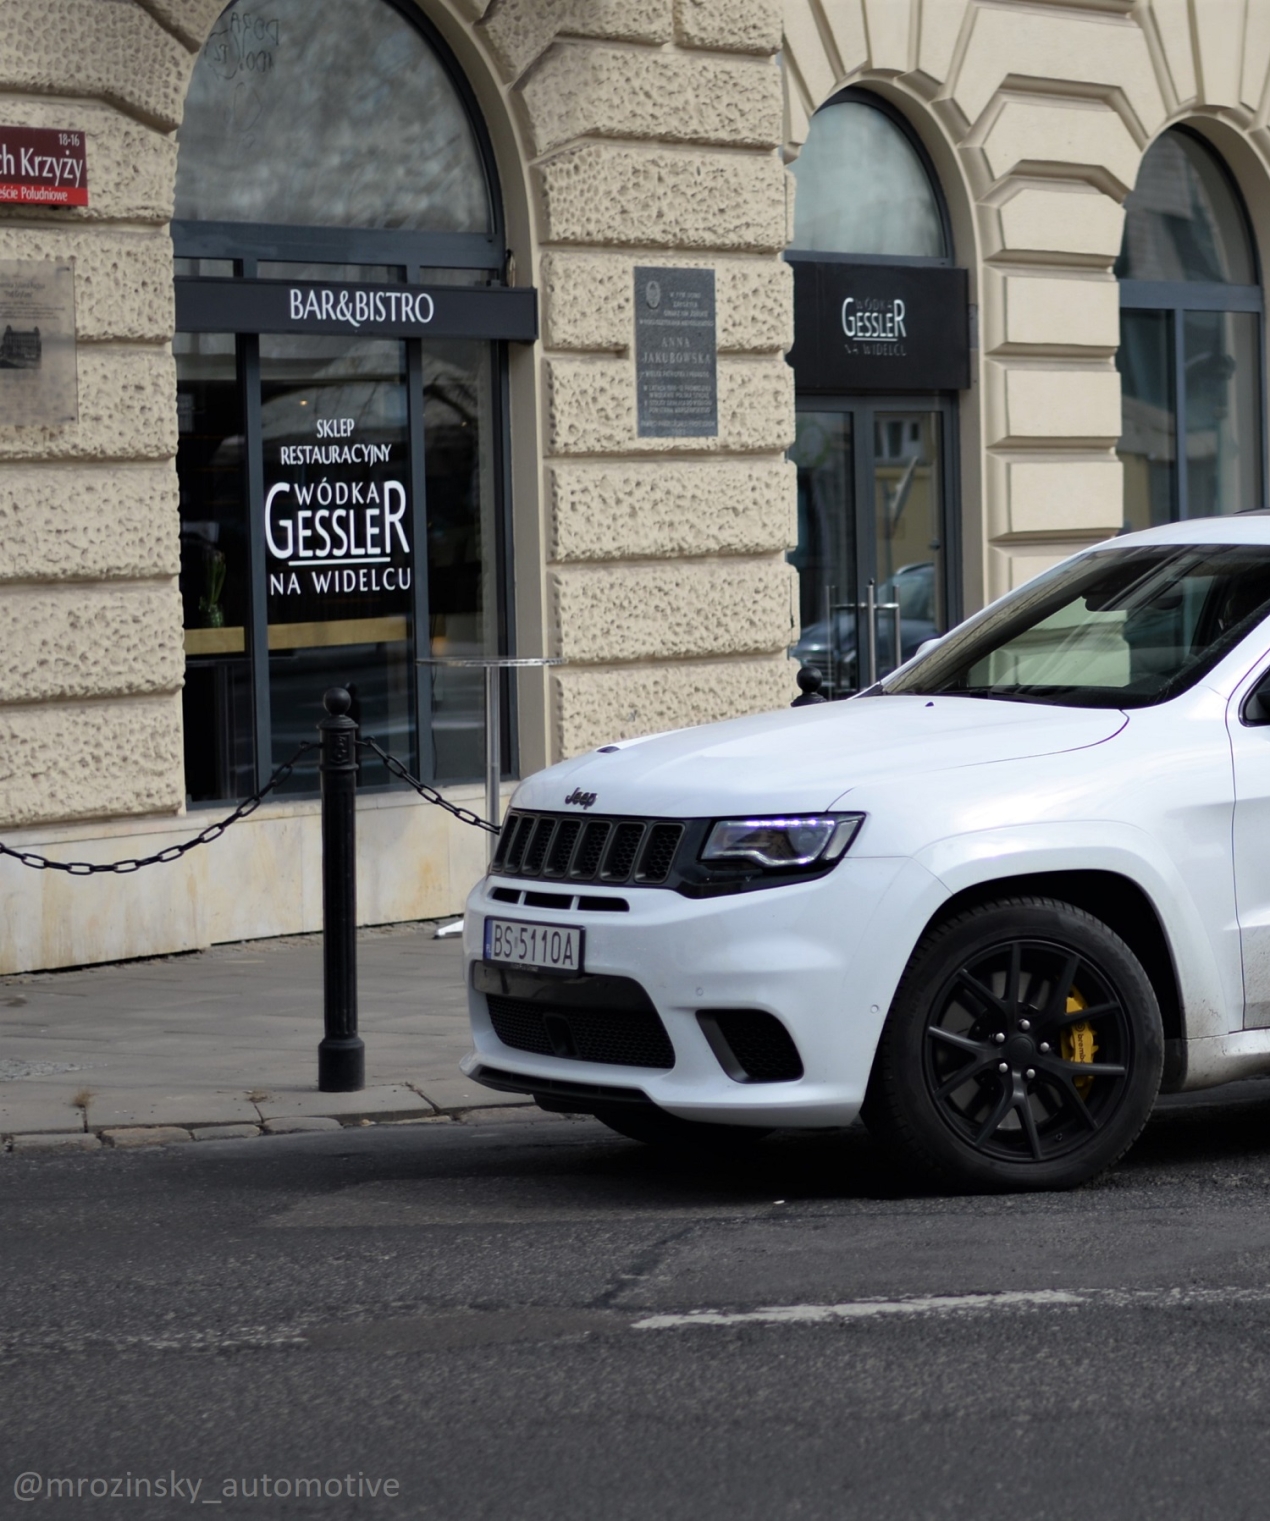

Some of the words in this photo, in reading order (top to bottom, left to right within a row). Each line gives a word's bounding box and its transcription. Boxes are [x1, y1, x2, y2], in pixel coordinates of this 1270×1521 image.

[58, 133, 80, 147] 18-16
[20, 147, 83, 188] Krzyży
[21, 186, 68, 201] Południowe
[290, 288, 435, 327] BAR&BISTRO
[841, 297, 907, 338] GESSLER
[661, 337, 690, 348] ANNA
[316, 418, 355, 438] SKLEP
[280, 444, 392, 467] RESTAURACYJNY
[294, 477, 380, 506] WÓDKA
[264, 480, 411, 560] GESSLER
[270, 572, 301, 596] NA
[311, 567, 411, 594] WIDELCU
[565, 786, 597, 810] Jeep
[494, 924, 513, 958] BS
[518, 927, 573, 966] 5110A
